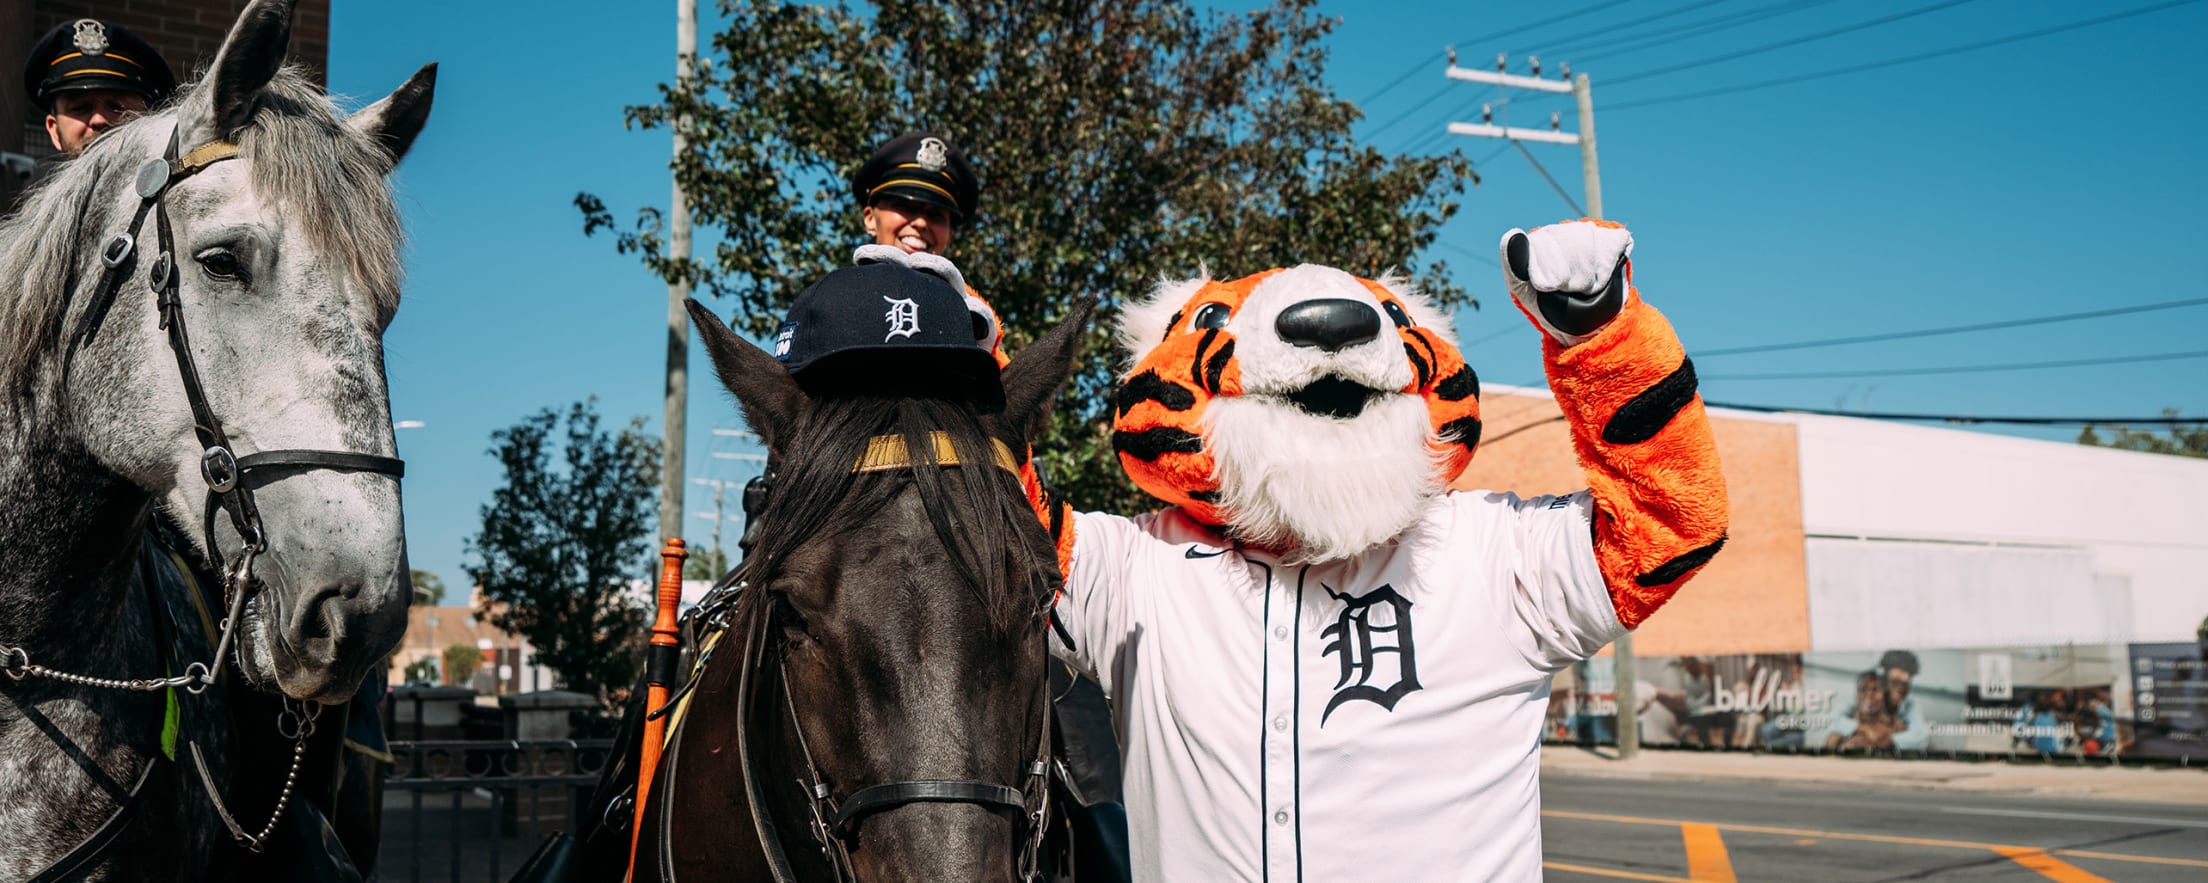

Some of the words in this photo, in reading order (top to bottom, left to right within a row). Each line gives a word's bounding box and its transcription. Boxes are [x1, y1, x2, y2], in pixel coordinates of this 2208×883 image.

[883, 295, 921, 343] D
[1321, 582, 1424, 729] D
[1714, 667, 1837, 712] ballmer
